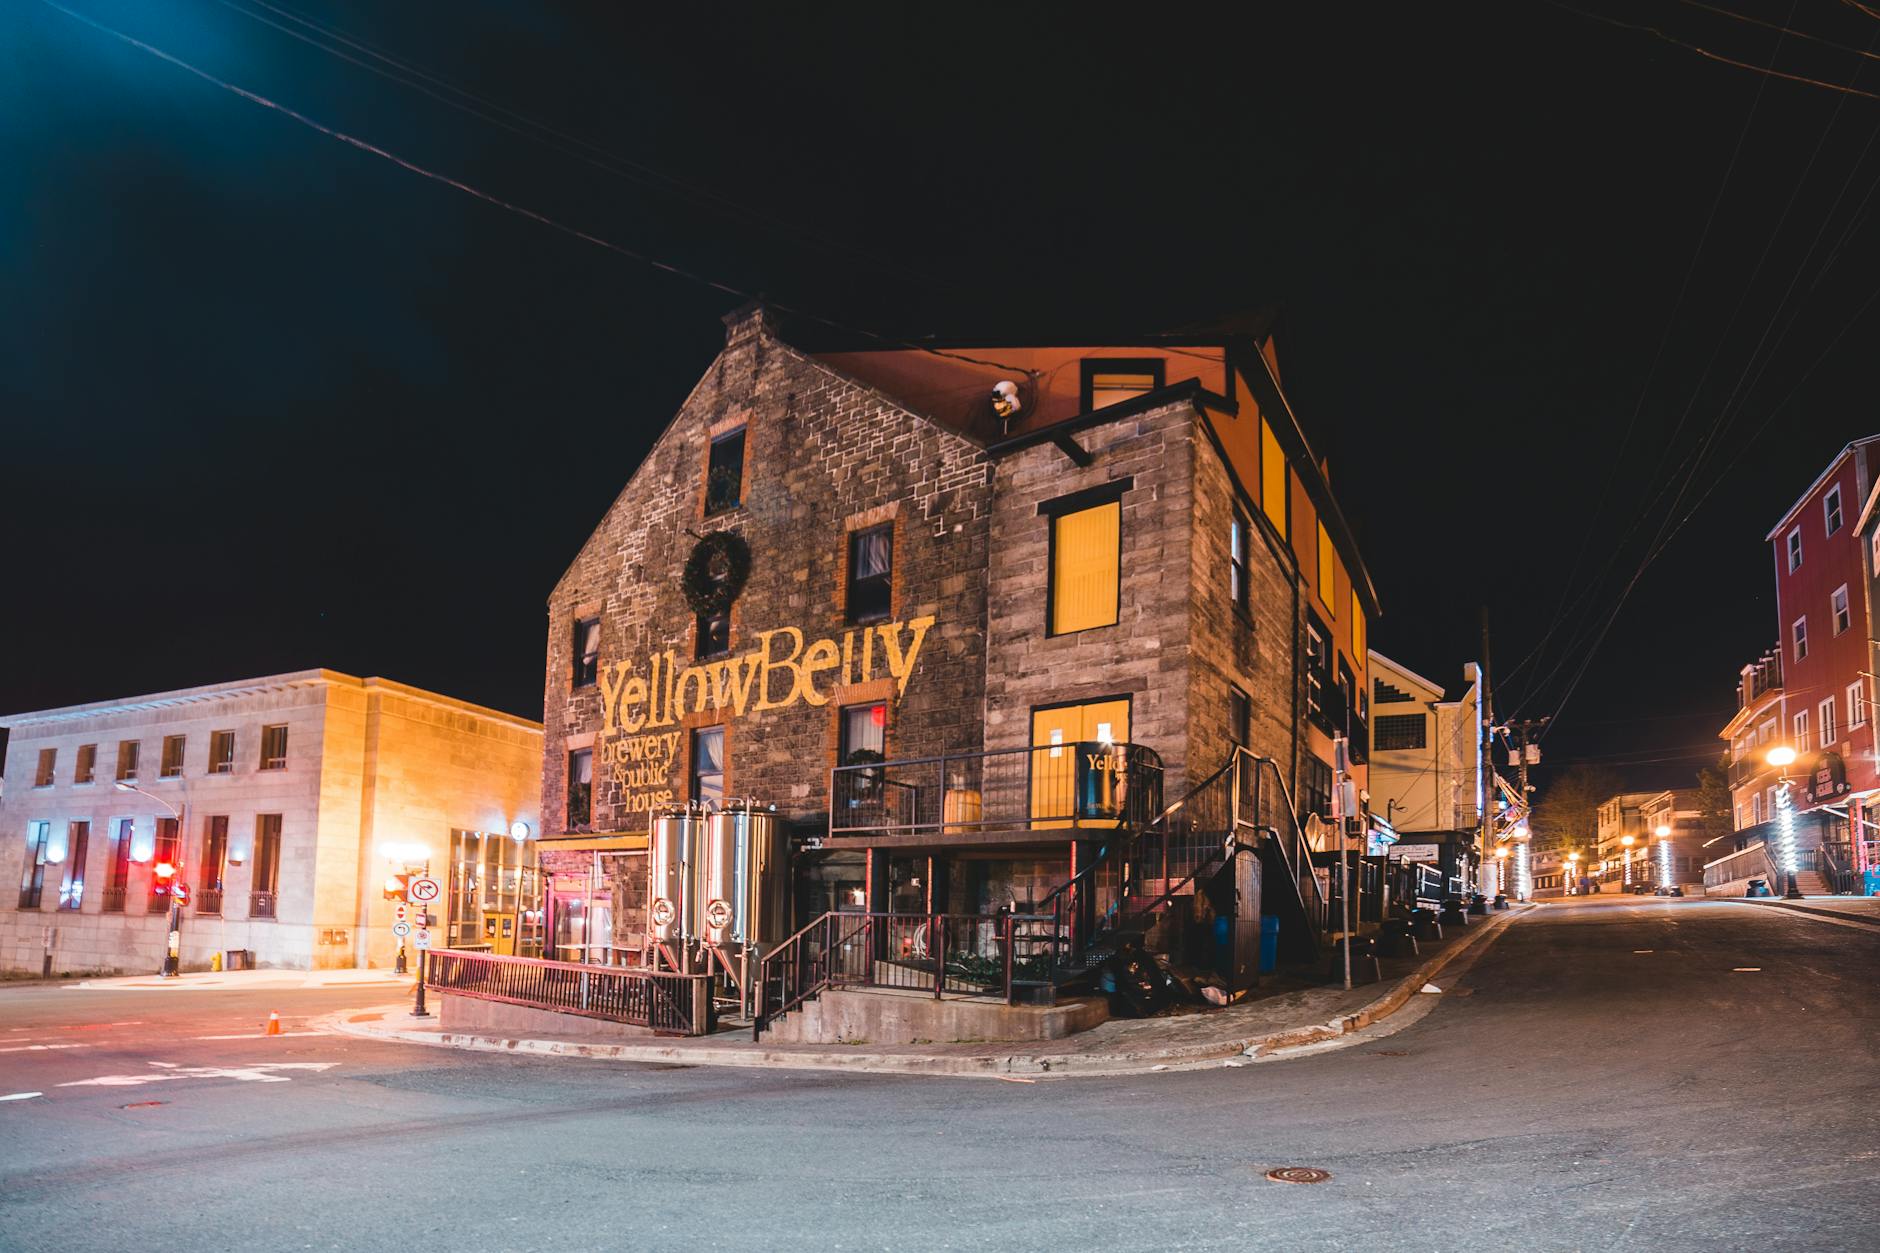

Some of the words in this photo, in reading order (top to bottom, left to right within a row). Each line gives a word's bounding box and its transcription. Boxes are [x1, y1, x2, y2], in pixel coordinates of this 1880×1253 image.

[600, 615, 936, 738] YellowBelly
[601, 731, 681, 767] brewery
[625, 789, 673, 813] house
